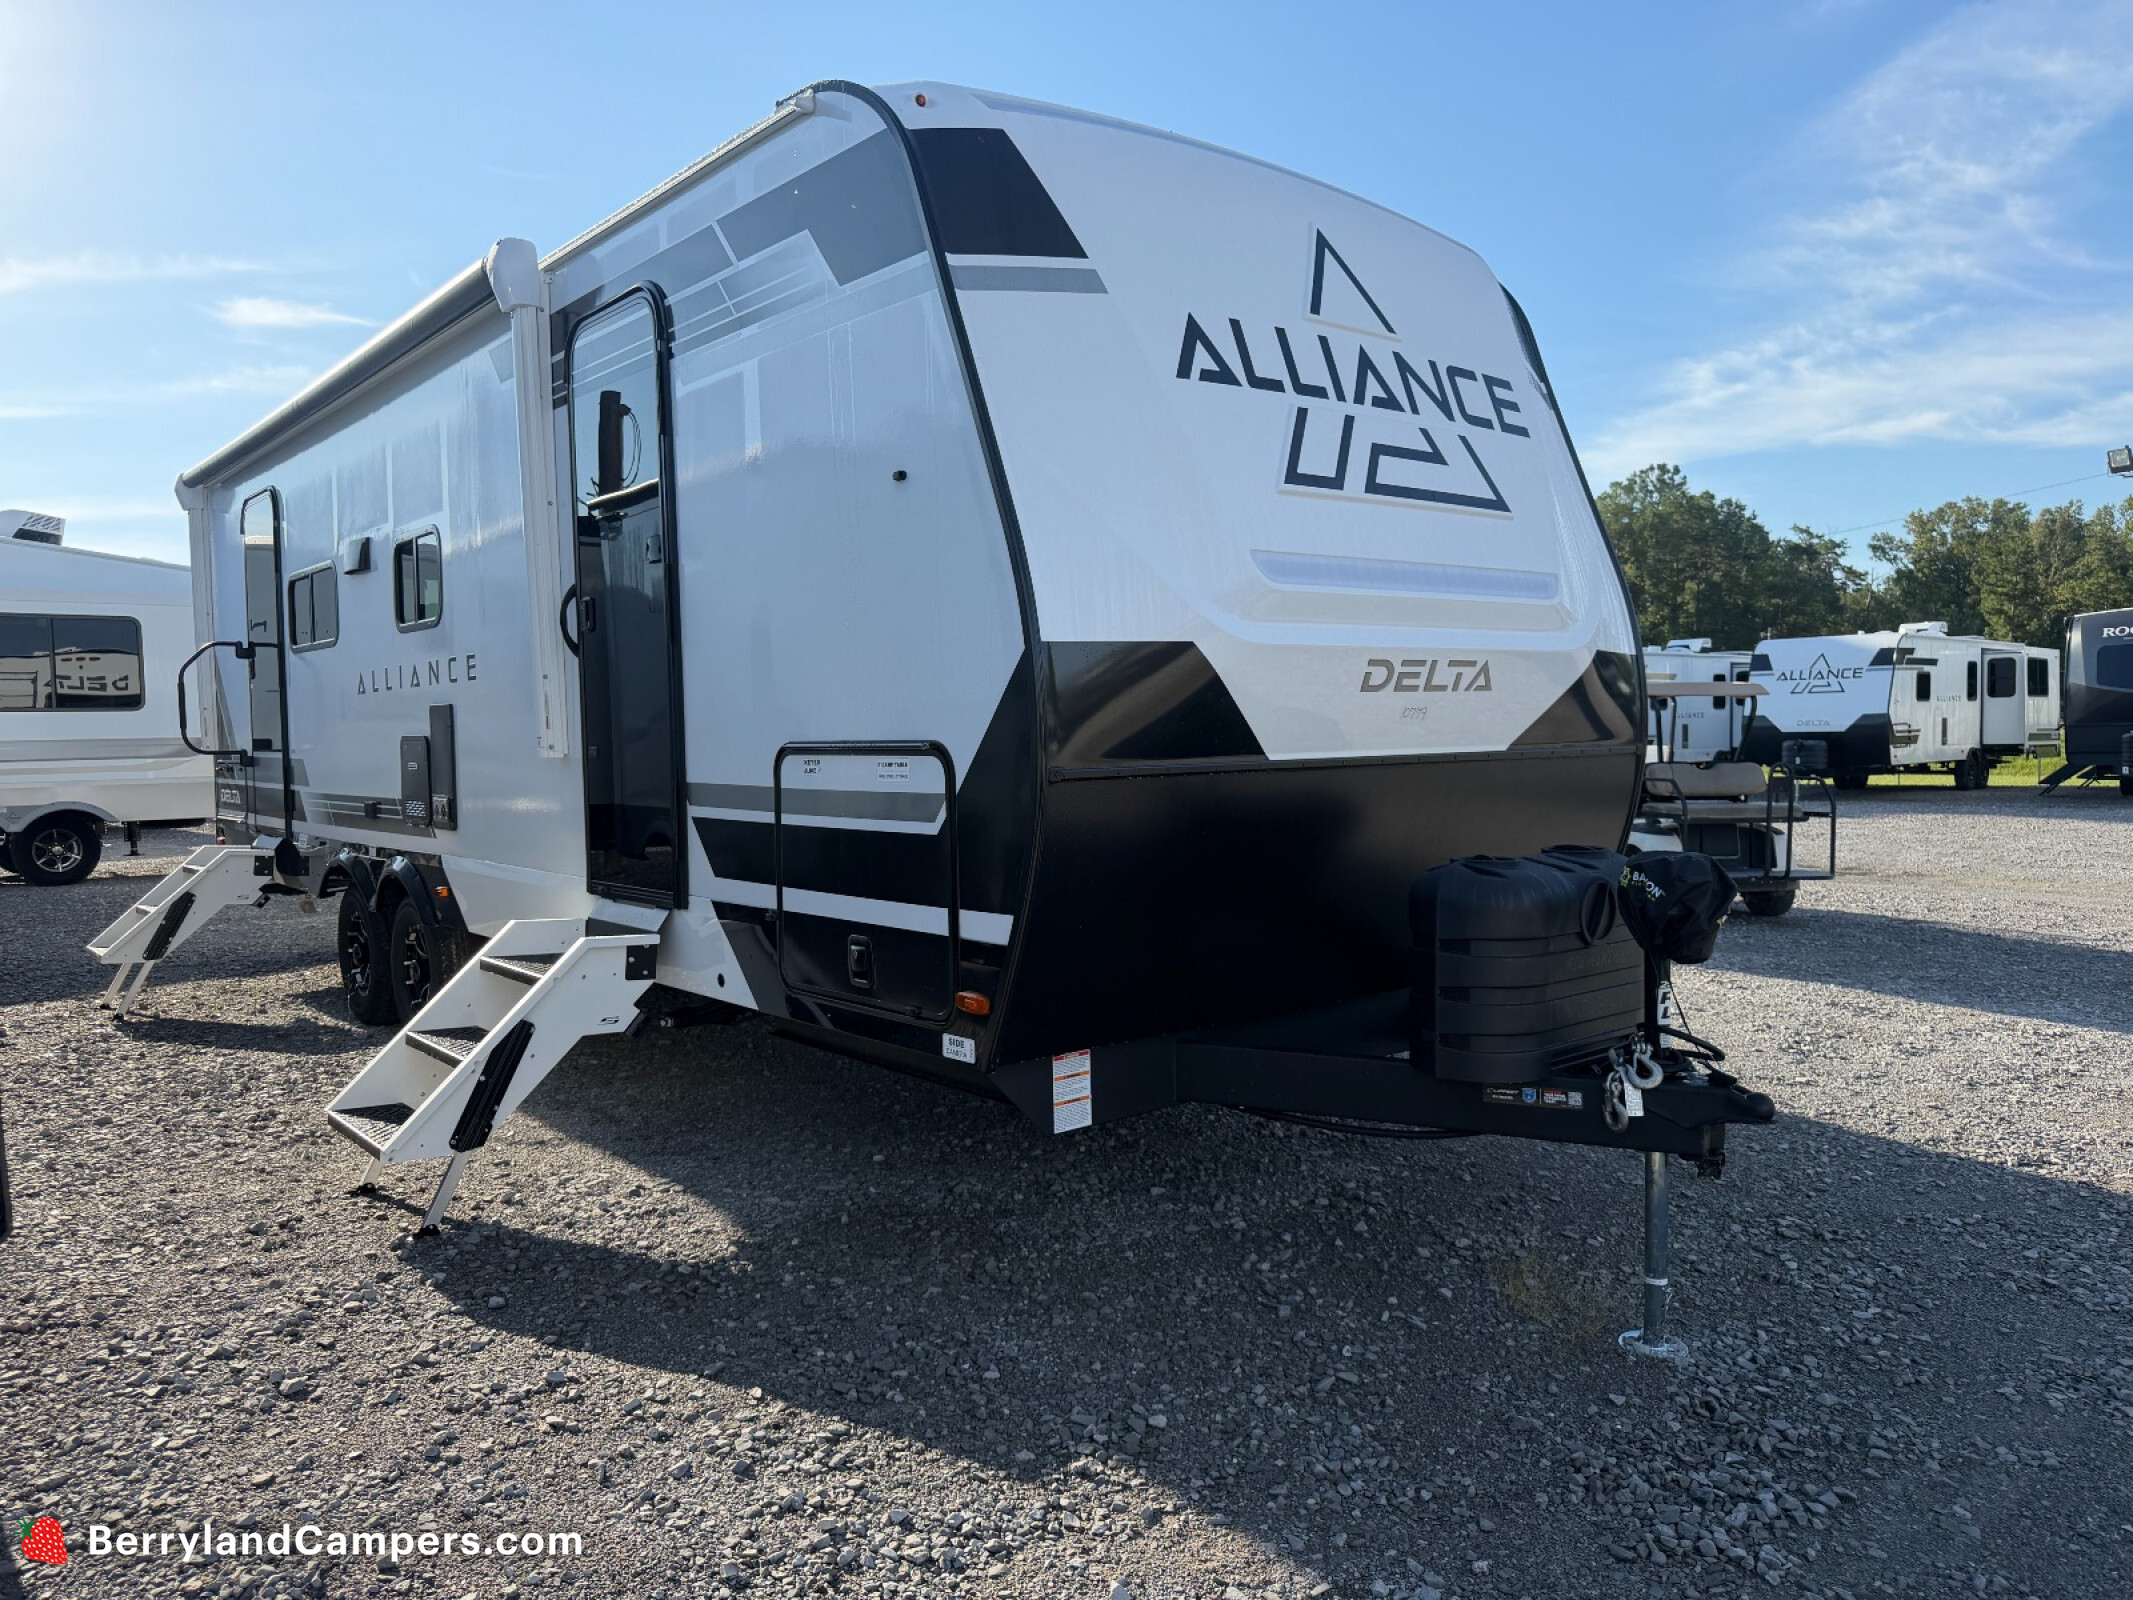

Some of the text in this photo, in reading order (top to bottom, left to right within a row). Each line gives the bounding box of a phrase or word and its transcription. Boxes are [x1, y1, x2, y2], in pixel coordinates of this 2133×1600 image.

[1176, 312, 1530, 438] ALLIANCE
[2102, 626, 2133, 638] RO
[358, 653, 476, 695] ALLIANCE
[1360, 658, 1492, 692] DELTA
[1776, 667, 1863, 681] ALLIANCE
[1796, 719, 1831, 727] DELTA
[948, 1037, 965, 1048] SIDE
